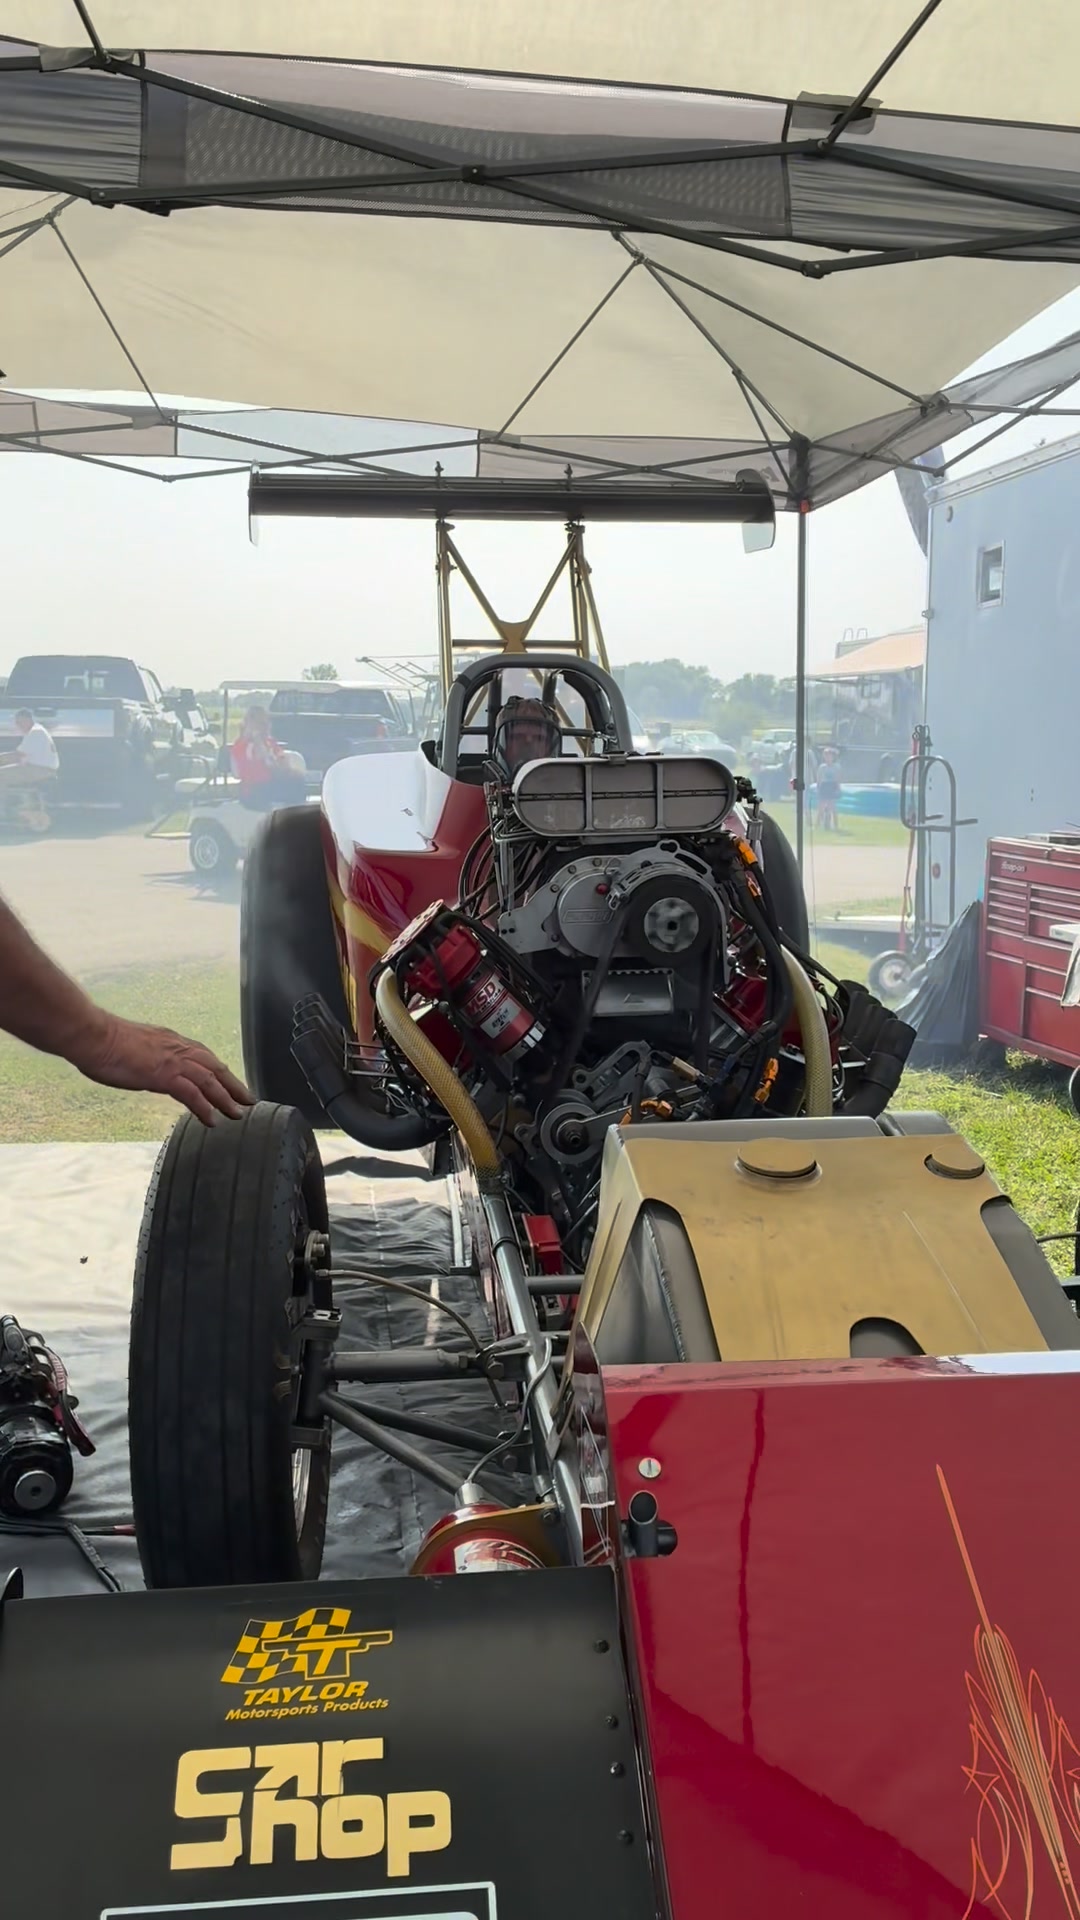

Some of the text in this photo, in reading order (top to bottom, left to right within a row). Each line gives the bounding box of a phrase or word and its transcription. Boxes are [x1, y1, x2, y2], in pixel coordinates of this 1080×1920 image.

[464, 981, 496, 1016] MSD
[243, 1681, 369, 1706] TAYLOR
[225, 1698, 389, 1720] Motorsports Products
